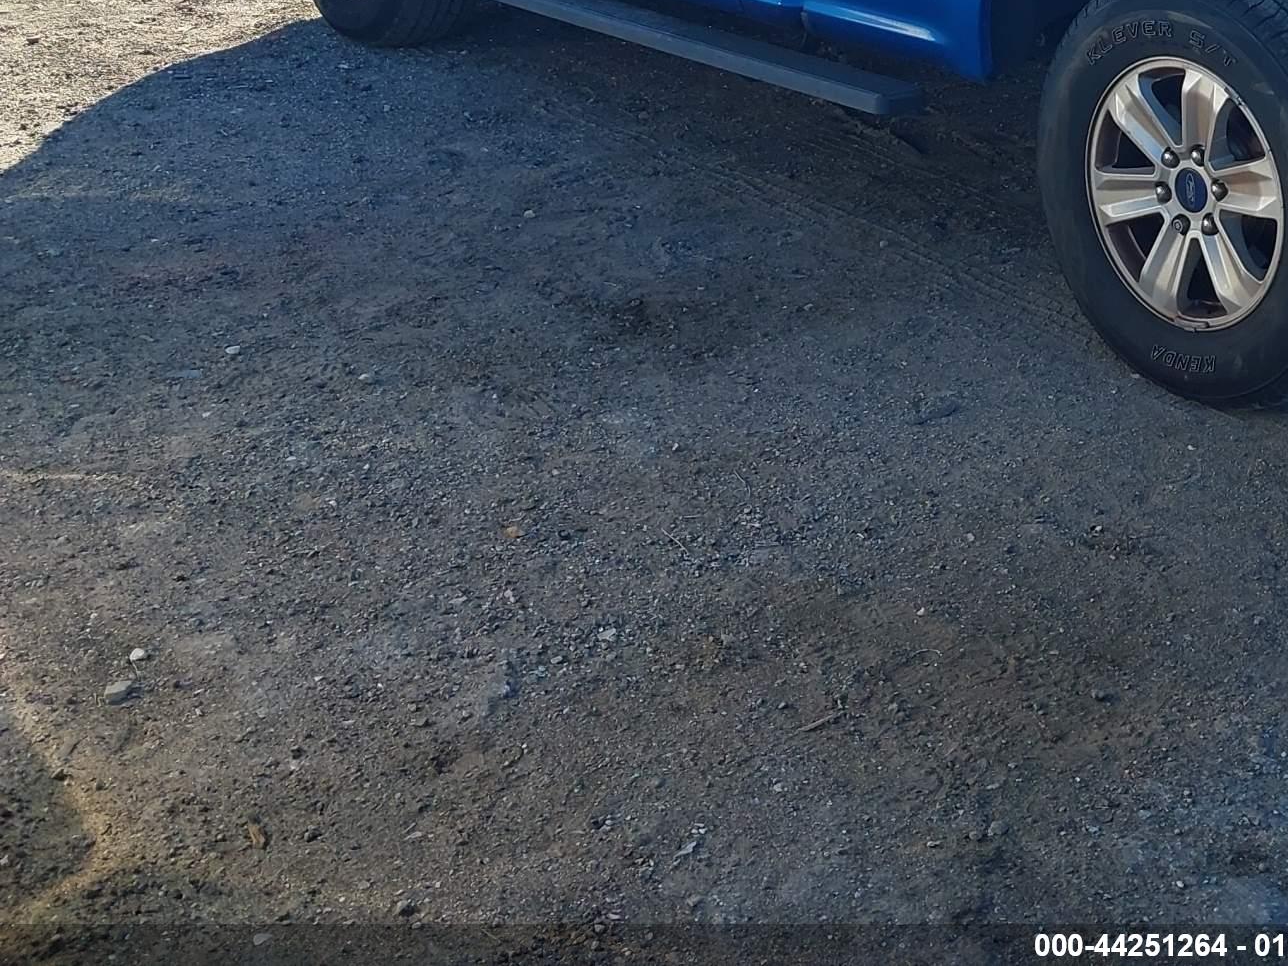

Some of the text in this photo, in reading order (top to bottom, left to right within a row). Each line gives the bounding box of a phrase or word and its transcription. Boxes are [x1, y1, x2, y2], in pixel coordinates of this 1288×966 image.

[1086, 20, 1237, 66] KLEVER S/T
[1150, 344, 1216, 372] KENDA
